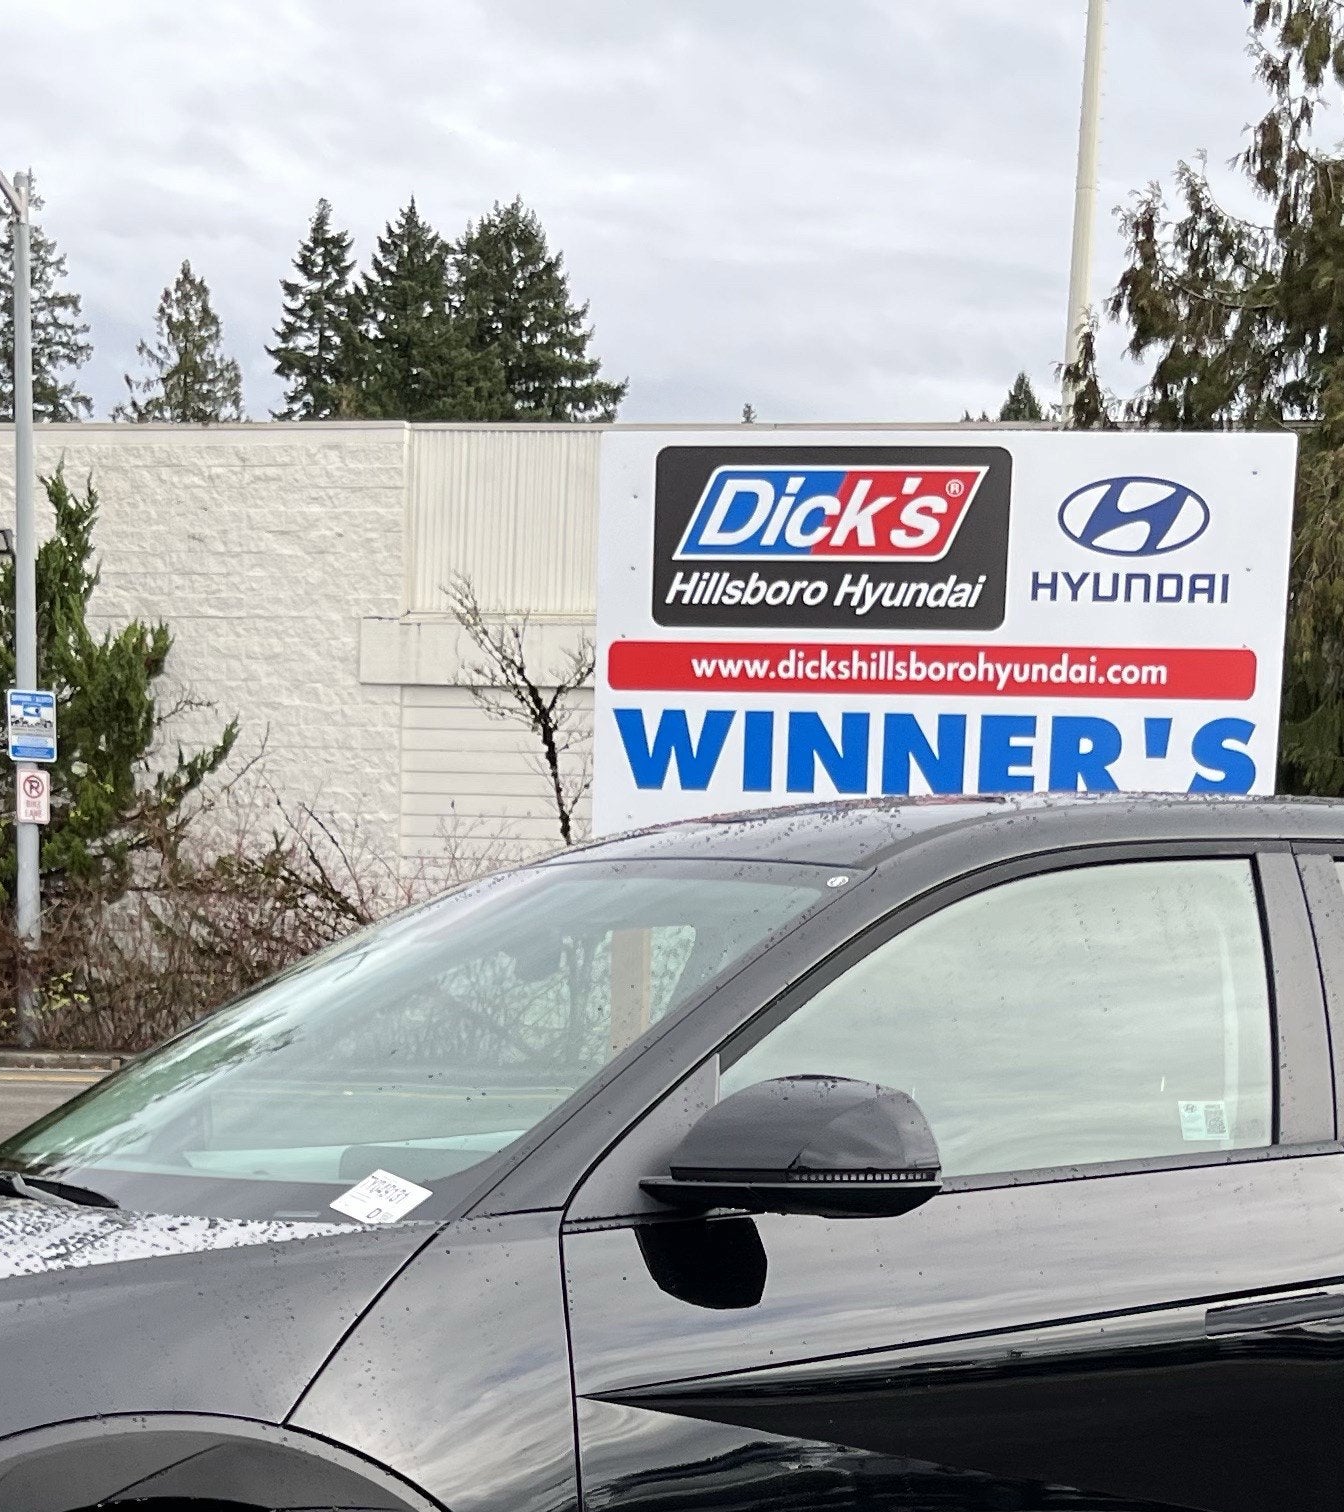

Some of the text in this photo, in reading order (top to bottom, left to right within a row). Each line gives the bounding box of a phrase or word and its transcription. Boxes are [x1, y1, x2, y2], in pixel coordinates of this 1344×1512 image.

[665, 571, 987, 615] Hillsboro Hyundai
[1032, 571, 1230, 604] HYUNDAI
[691, 649, 1168, 690] www.dickshillsborohyundai.com
[613, 708, 1257, 795] WINNER'S
